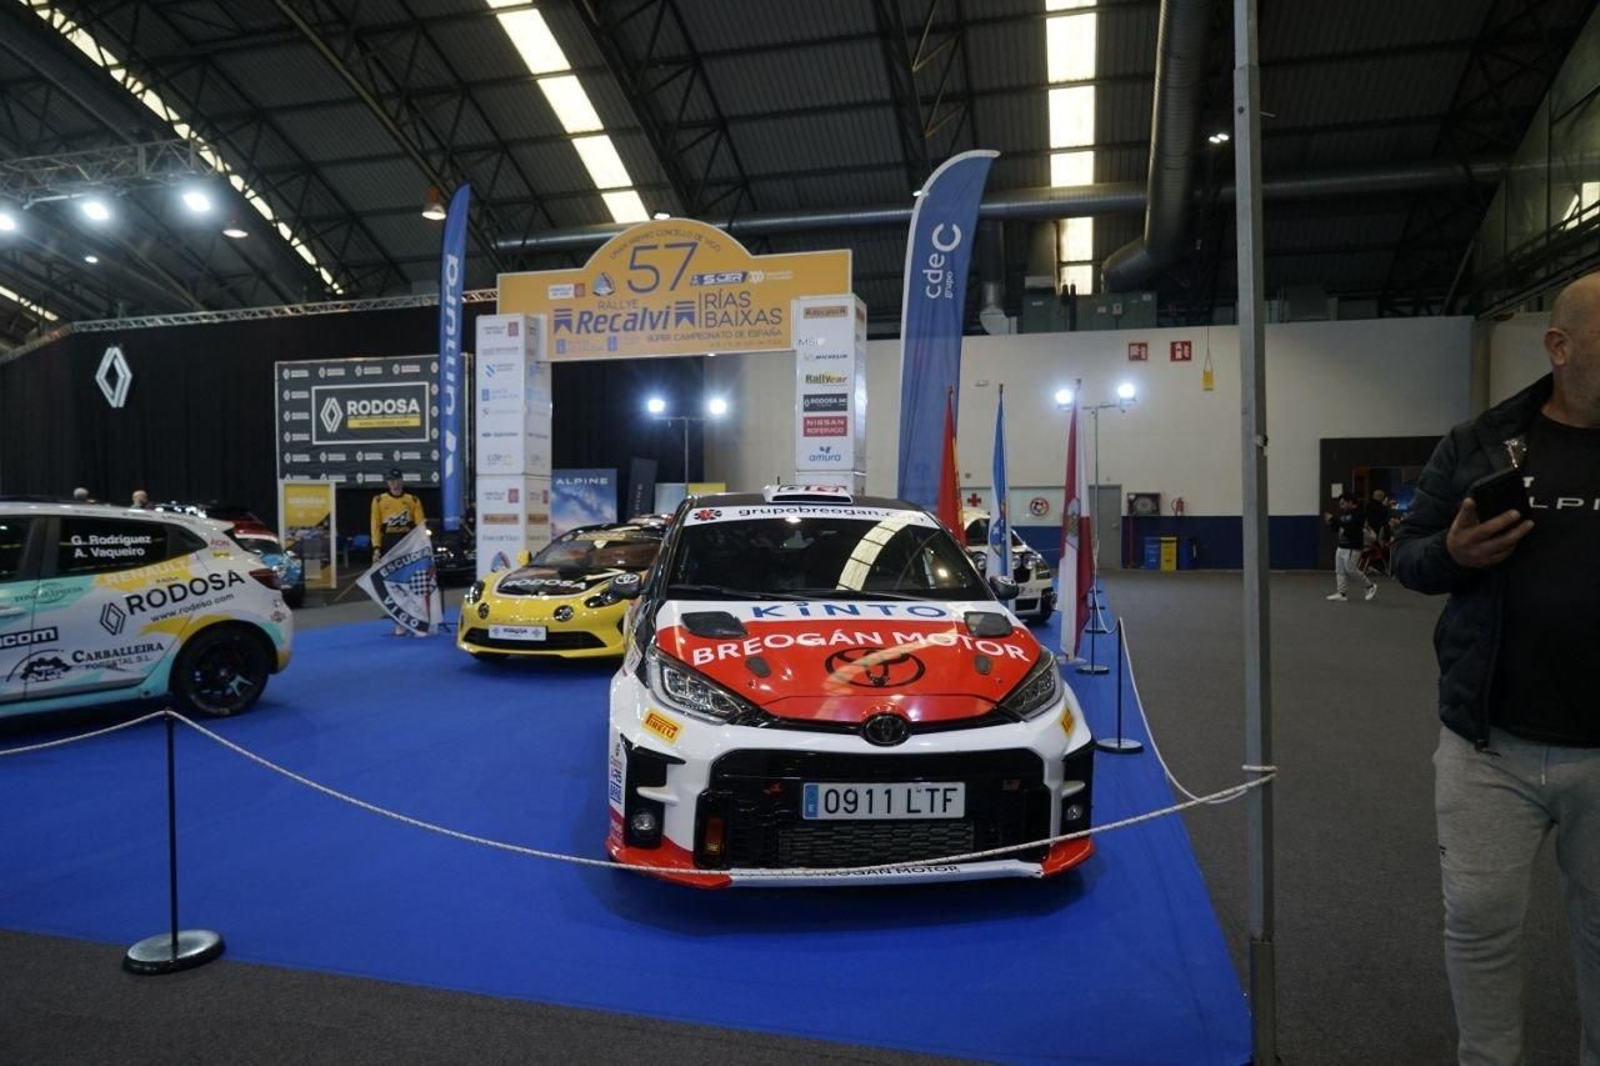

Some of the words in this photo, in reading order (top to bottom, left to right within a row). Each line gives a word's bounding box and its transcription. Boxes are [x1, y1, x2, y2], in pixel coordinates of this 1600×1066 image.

[627, 241, 699, 294] 57
[944, 271, 954, 299] grupo
[599, 298, 639, 310] RALLYE
[704, 288, 751, 310] RÍAS
[576, 306, 671, 335] Recalvi
[704, 308, 783, 329] BAIXAS
[647, 334, 672, 343] SUPER
[673, 331, 733, 342] CAMPEONATO
[735, 330, 744, 338] DE
[748, 328, 782, 338] ESPAÑA
[346, 398, 421, 415] RODOSA
[809, 454, 842, 462] amura
[556, 477, 609, 485] ALPINE
[1529, 496, 1600, 510] LPI
[71, 535, 87, 545] G.
[74, 548, 88, 558] A.
[90, 546, 146, 559] Vaqueiro
[104, 557, 189, 586] RENAULT
[125, 569, 246, 615] RODOSA
[501, 578, 586, 590] RODOSA
[384, 595, 419, 627] VIGO
[72, 641, 164, 663] CARBALLEIRA
[692, 629, 883, 667] BREOGÁN
[894, 629, 1030, 663] MOTOR
[824, 788, 893, 814] 0911
[906, 787, 959, 814] LTF
[896, 865, 959, 874] MOTOR
